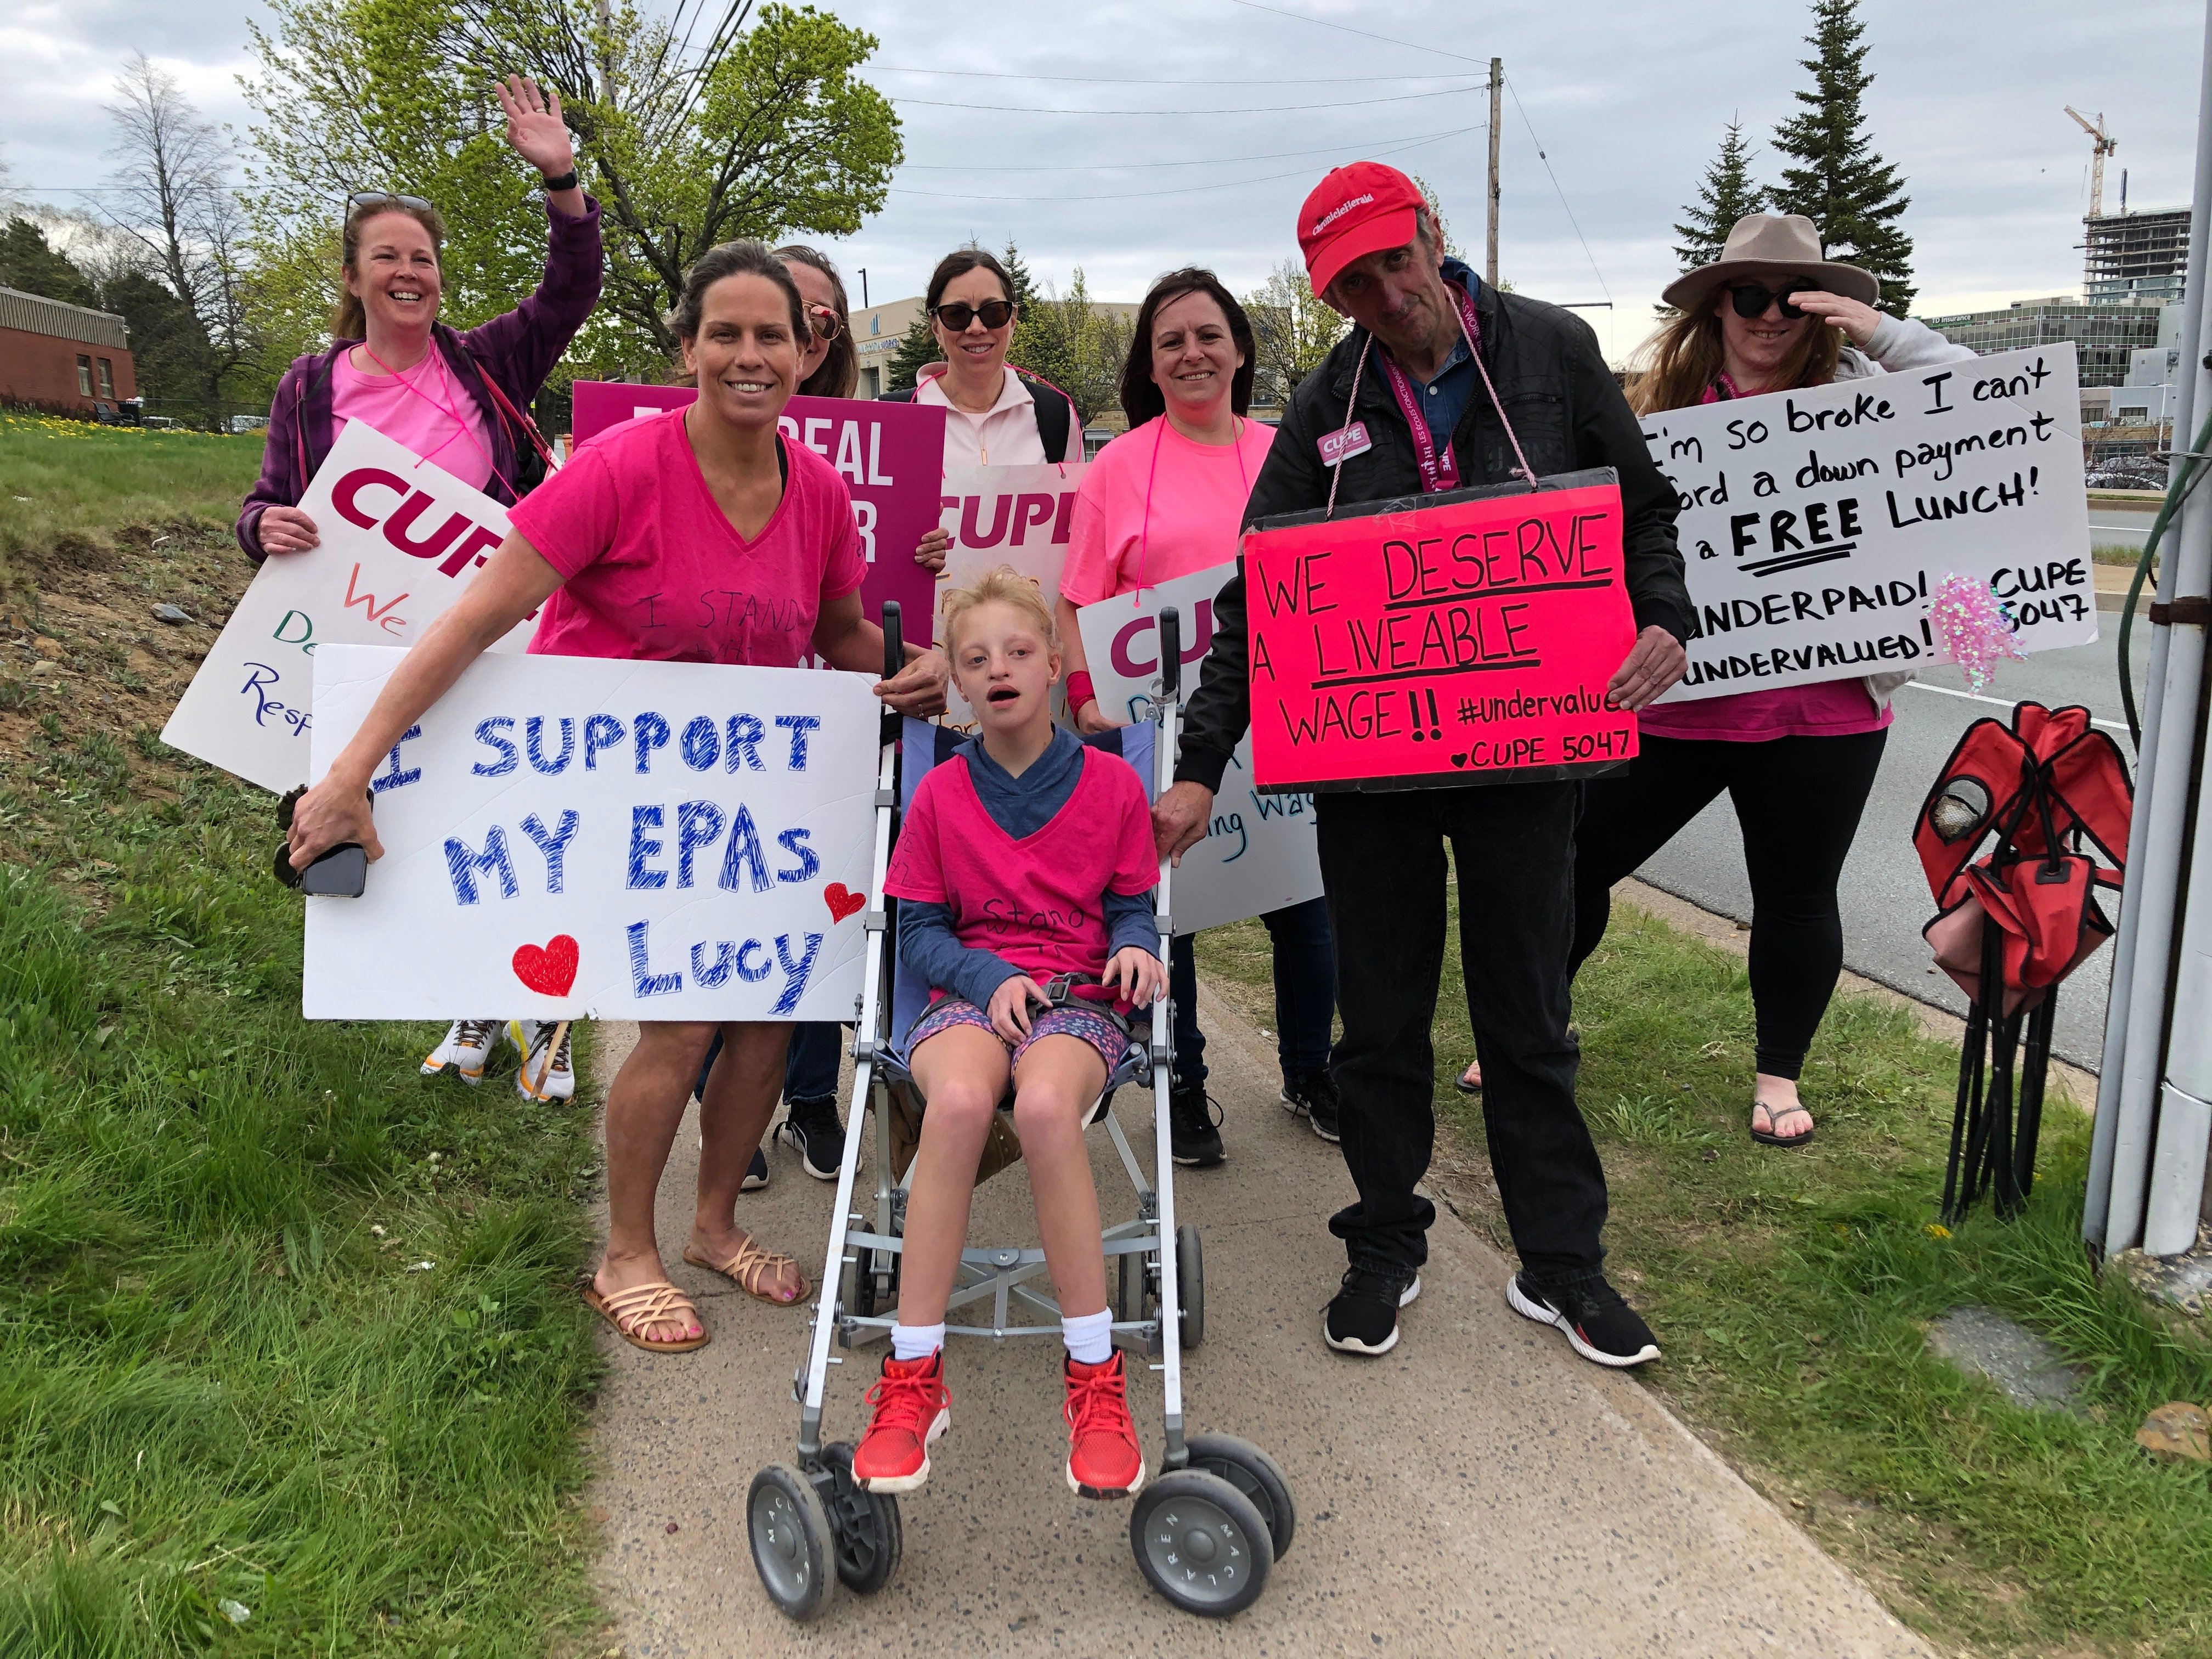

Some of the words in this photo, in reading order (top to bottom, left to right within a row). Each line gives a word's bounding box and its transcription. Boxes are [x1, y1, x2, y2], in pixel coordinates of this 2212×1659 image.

[1312, 193, 1374, 236] ChronicleHerald
[1465, 309, 1481, 339] WORK
[1942, 314, 1972, 323] Insurance
[1323, 427, 1362, 453] CUPE
[1418, 432, 1426, 444] LES
[1726, 419, 1769, 450] so
[1786, 393, 1895, 434] broke
[1922, 371, 1953, 415] I
[1973, 357, 2052, 402] can't
[1667, 470, 1729, 511] ord
[1752, 471, 1781, 497] a
[1795, 450, 1880, 489] down
[1896, 411, 2055, 481] payment
[331, 467, 513, 587] CUP
[1695, 539, 1719, 560] a
[1730, 497, 1864, 557] FREE
[1886, 466, 2040, 529] LUNCH!
[343, 562, 410, 637] We
[1257, 551, 1339, 619] WE
[1382, 513, 1614, 601] DESERVE
[1990, 557, 2087, 598] CUPE
[638, 592, 667, 629] I
[696, 589, 800, 632] STAND
[1110, 597, 1223, 678] CU
[1250, 631, 1276, 684] A
[1313, 603, 1538, 677] LIVEABLE
[1681, 618, 1935, 686] UNDERVALUED!
[1998, 594, 2090, 634] 5047
[240, 662, 312, 738] Resp
[373, 724, 422, 794] I
[470, 711, 821, 778] SUPPORT
[1470, 737, 1548, 769] CUPE
[1561, 729, 1630, 762] 5047
[443, 809, 580, 906] MY
[625, 799, 821, 893] EPAs
[624, 918, 824, 1017] Lucy
